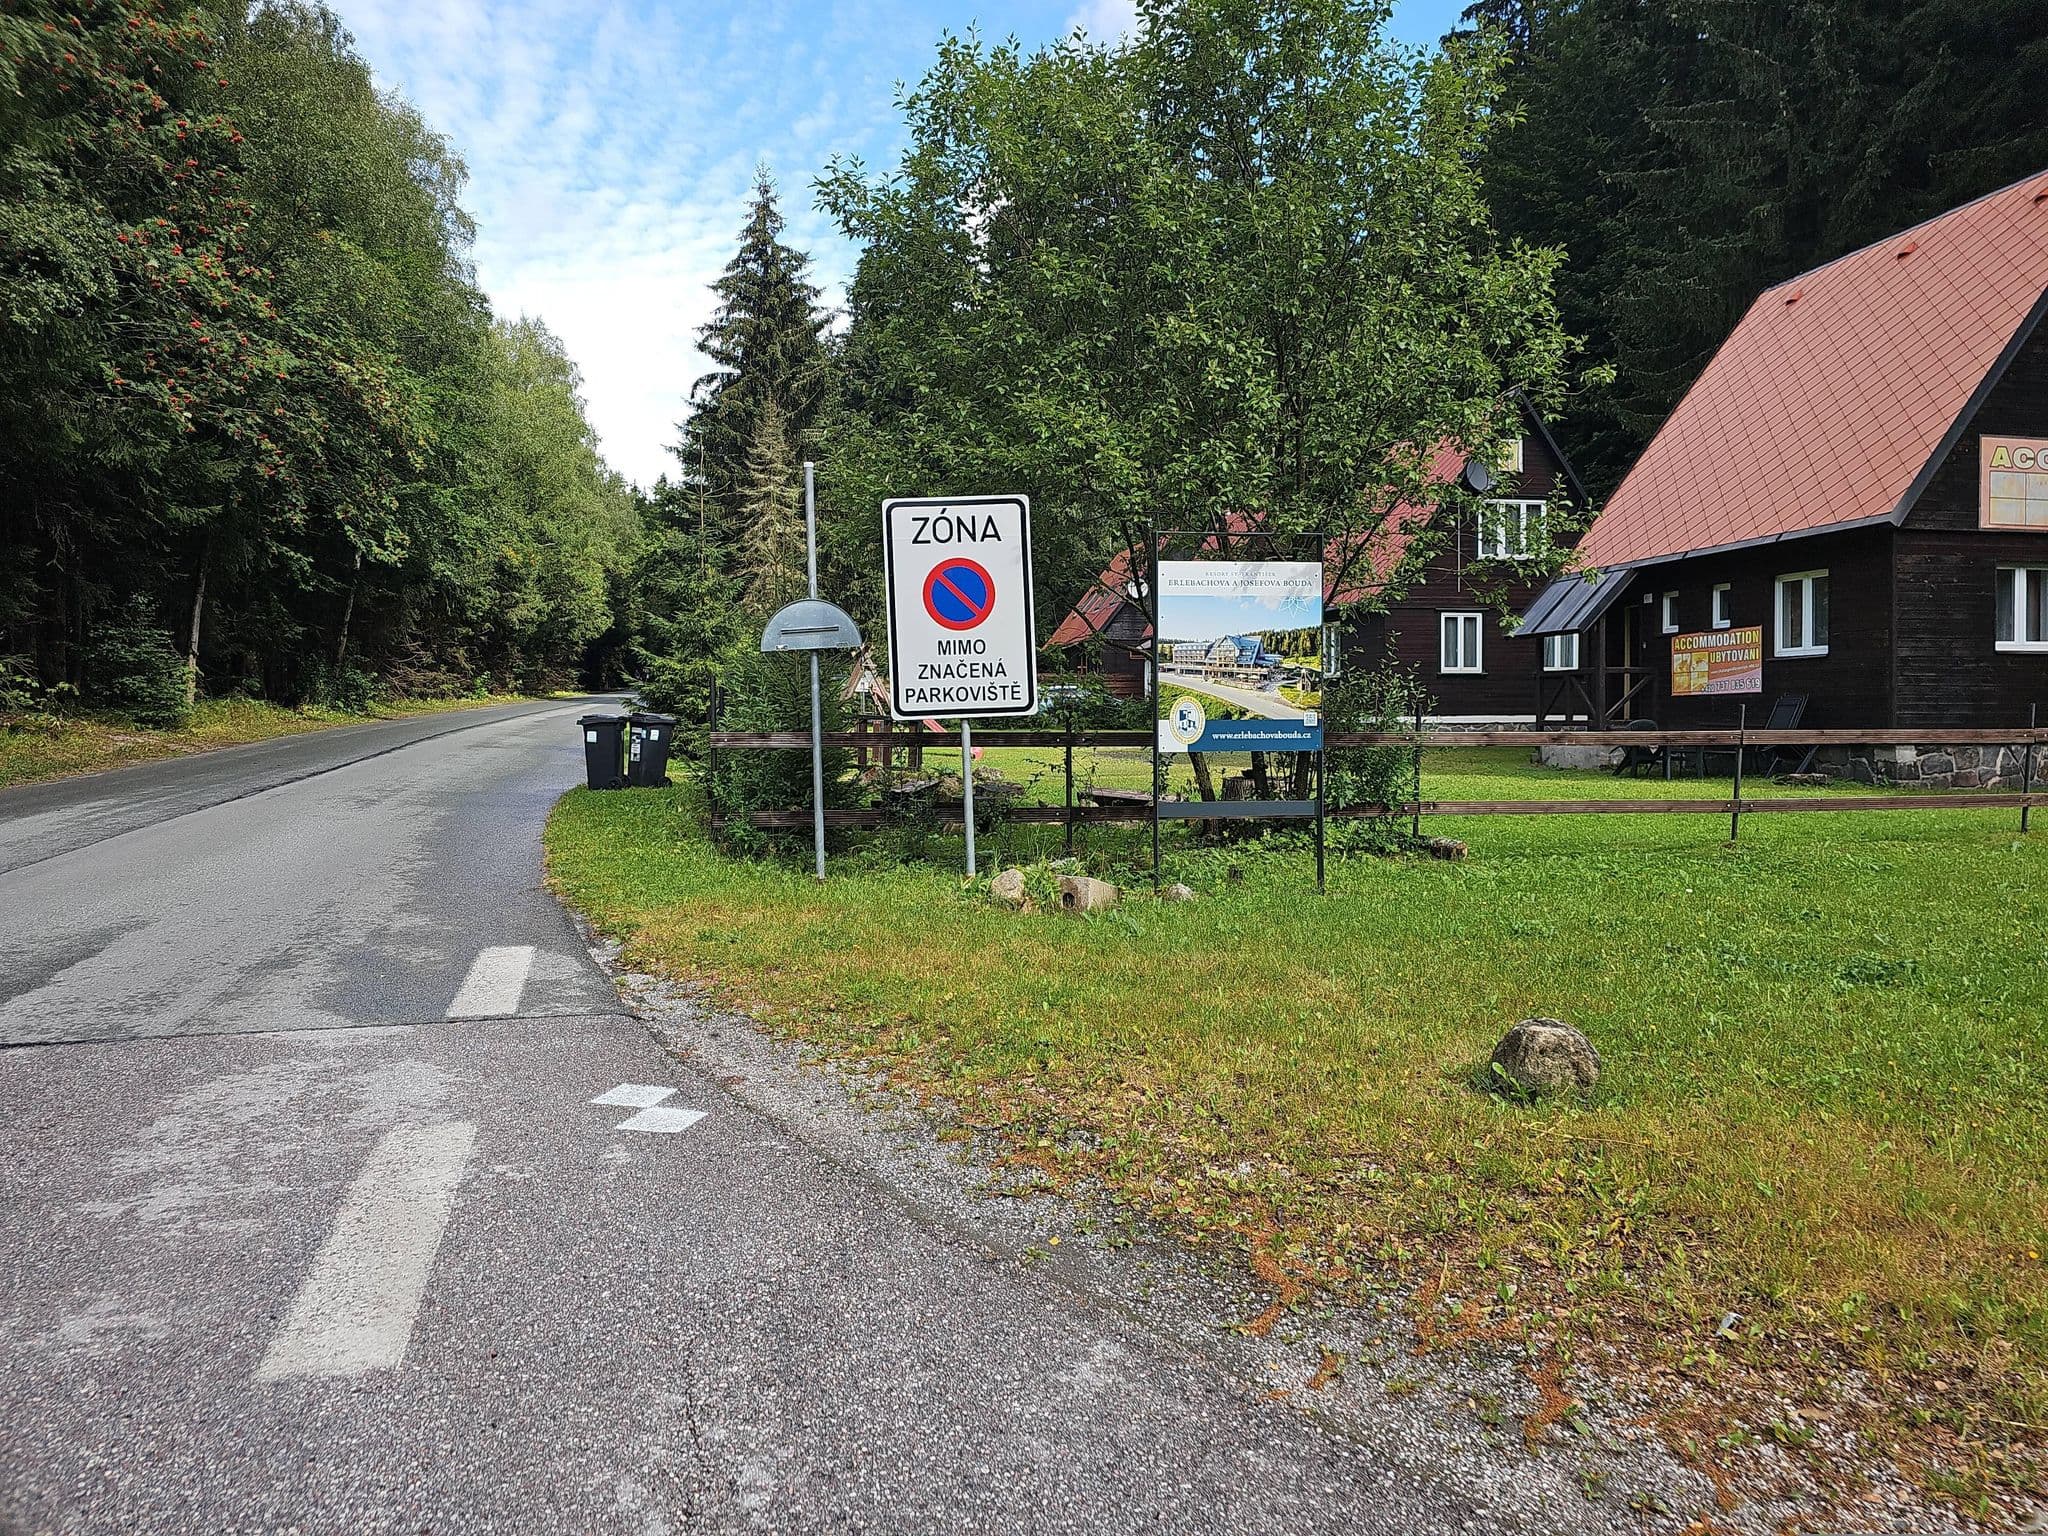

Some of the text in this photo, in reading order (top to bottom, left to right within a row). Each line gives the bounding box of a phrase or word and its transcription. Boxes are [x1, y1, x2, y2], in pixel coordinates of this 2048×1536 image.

[911, 507, 1002, 545] ZÓNA
[1168, 579, 1313, 588] ERLEBACHOVA A JOSEFOVA BOUDA
[937, 638, 986, 656] MIMO
[1674, 630, 1759, 651] ACCOMMODATION
[917, 657, 1008, 680] ZNAČENÁ
[905, 681, 1022, 704] PARKOVIŠTĚ
[1211, 730, 1312, 740] www.erlebachovabouda.cz
